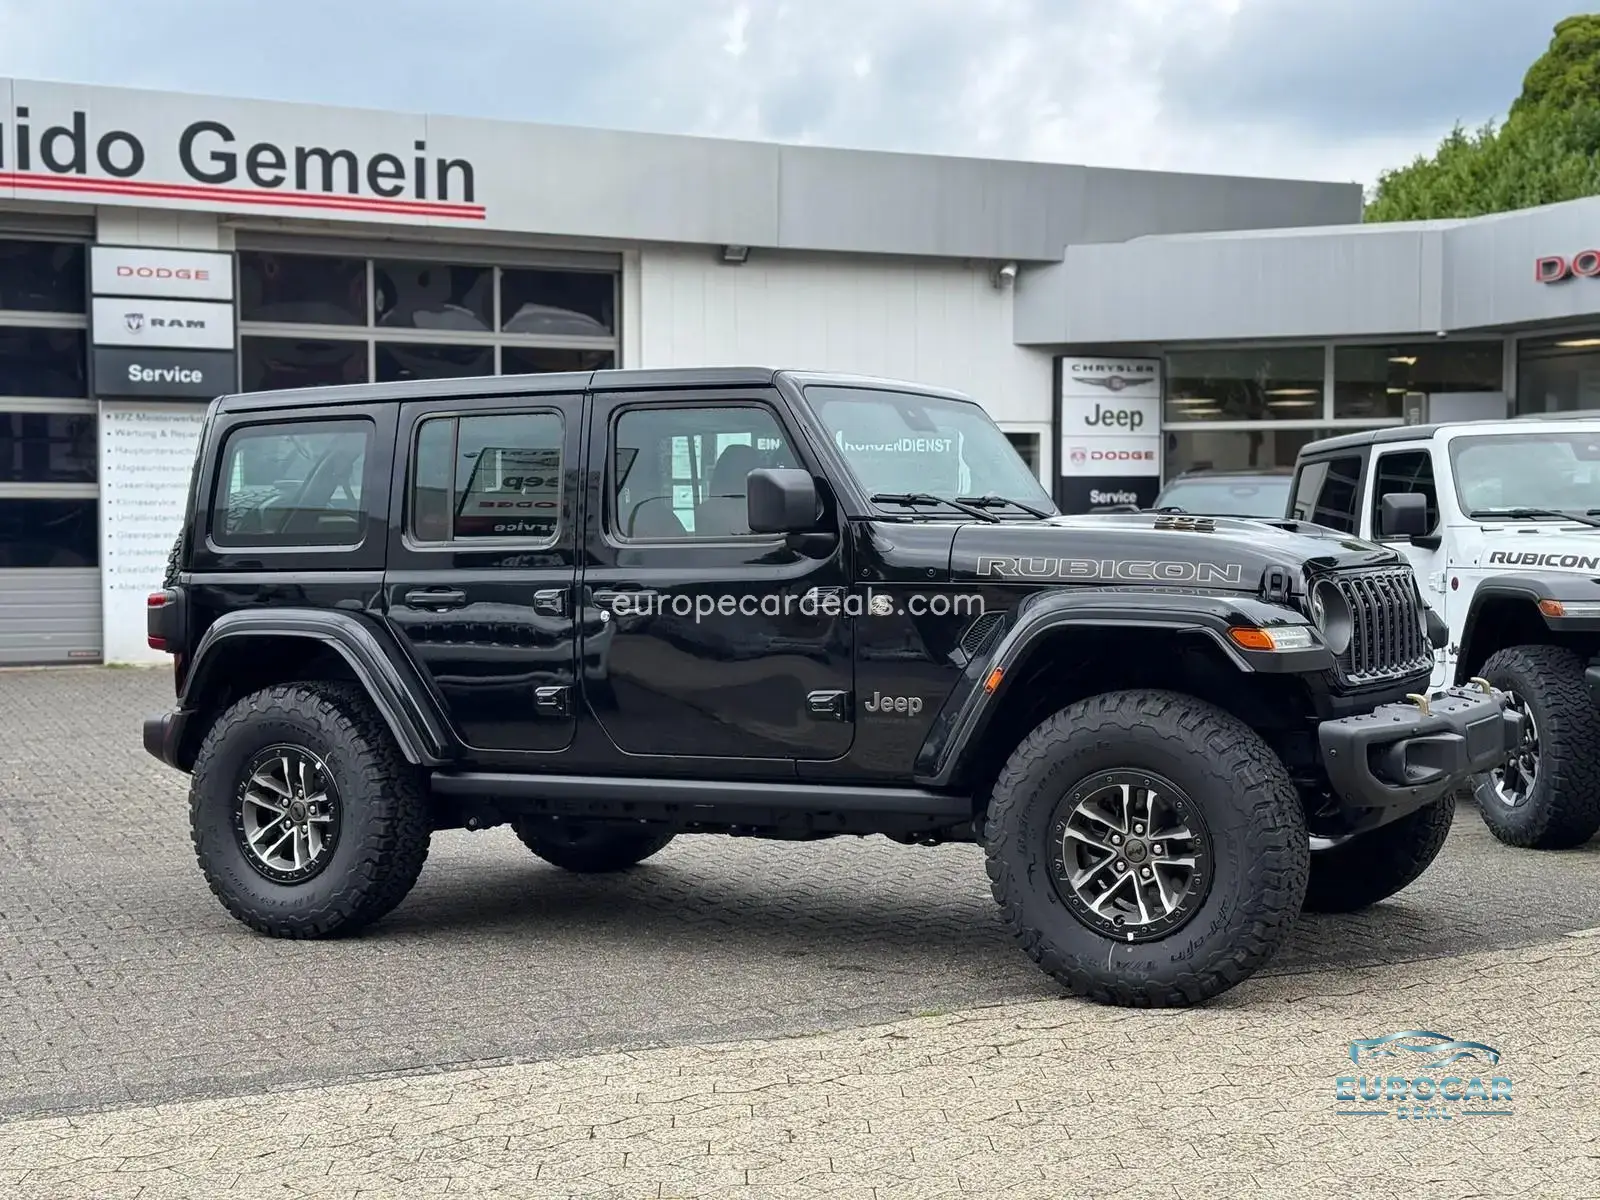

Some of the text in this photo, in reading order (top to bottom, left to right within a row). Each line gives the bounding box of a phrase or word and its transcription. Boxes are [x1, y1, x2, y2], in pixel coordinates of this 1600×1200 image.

[0, 106, 475, 202] ido Gemein
[117, 266, 209, 280] DODGE
[150, 318, 206, 329] RAM
[128, 364, 203, 383] Service
[1072, 364, 1154, 372] CHRYSLER
[1084, 403, 1144, 431] Jeep
[757, 438, 781, 450] EIN
[1091, 451, 1154, 460] DODGE
[1089, 489, 1138, 503] Service
[1489, 551, 1600, 569] RUBICON
[976, 556, 1242, 584] RUBICON
[864, 691, 923, 716] Jeep
